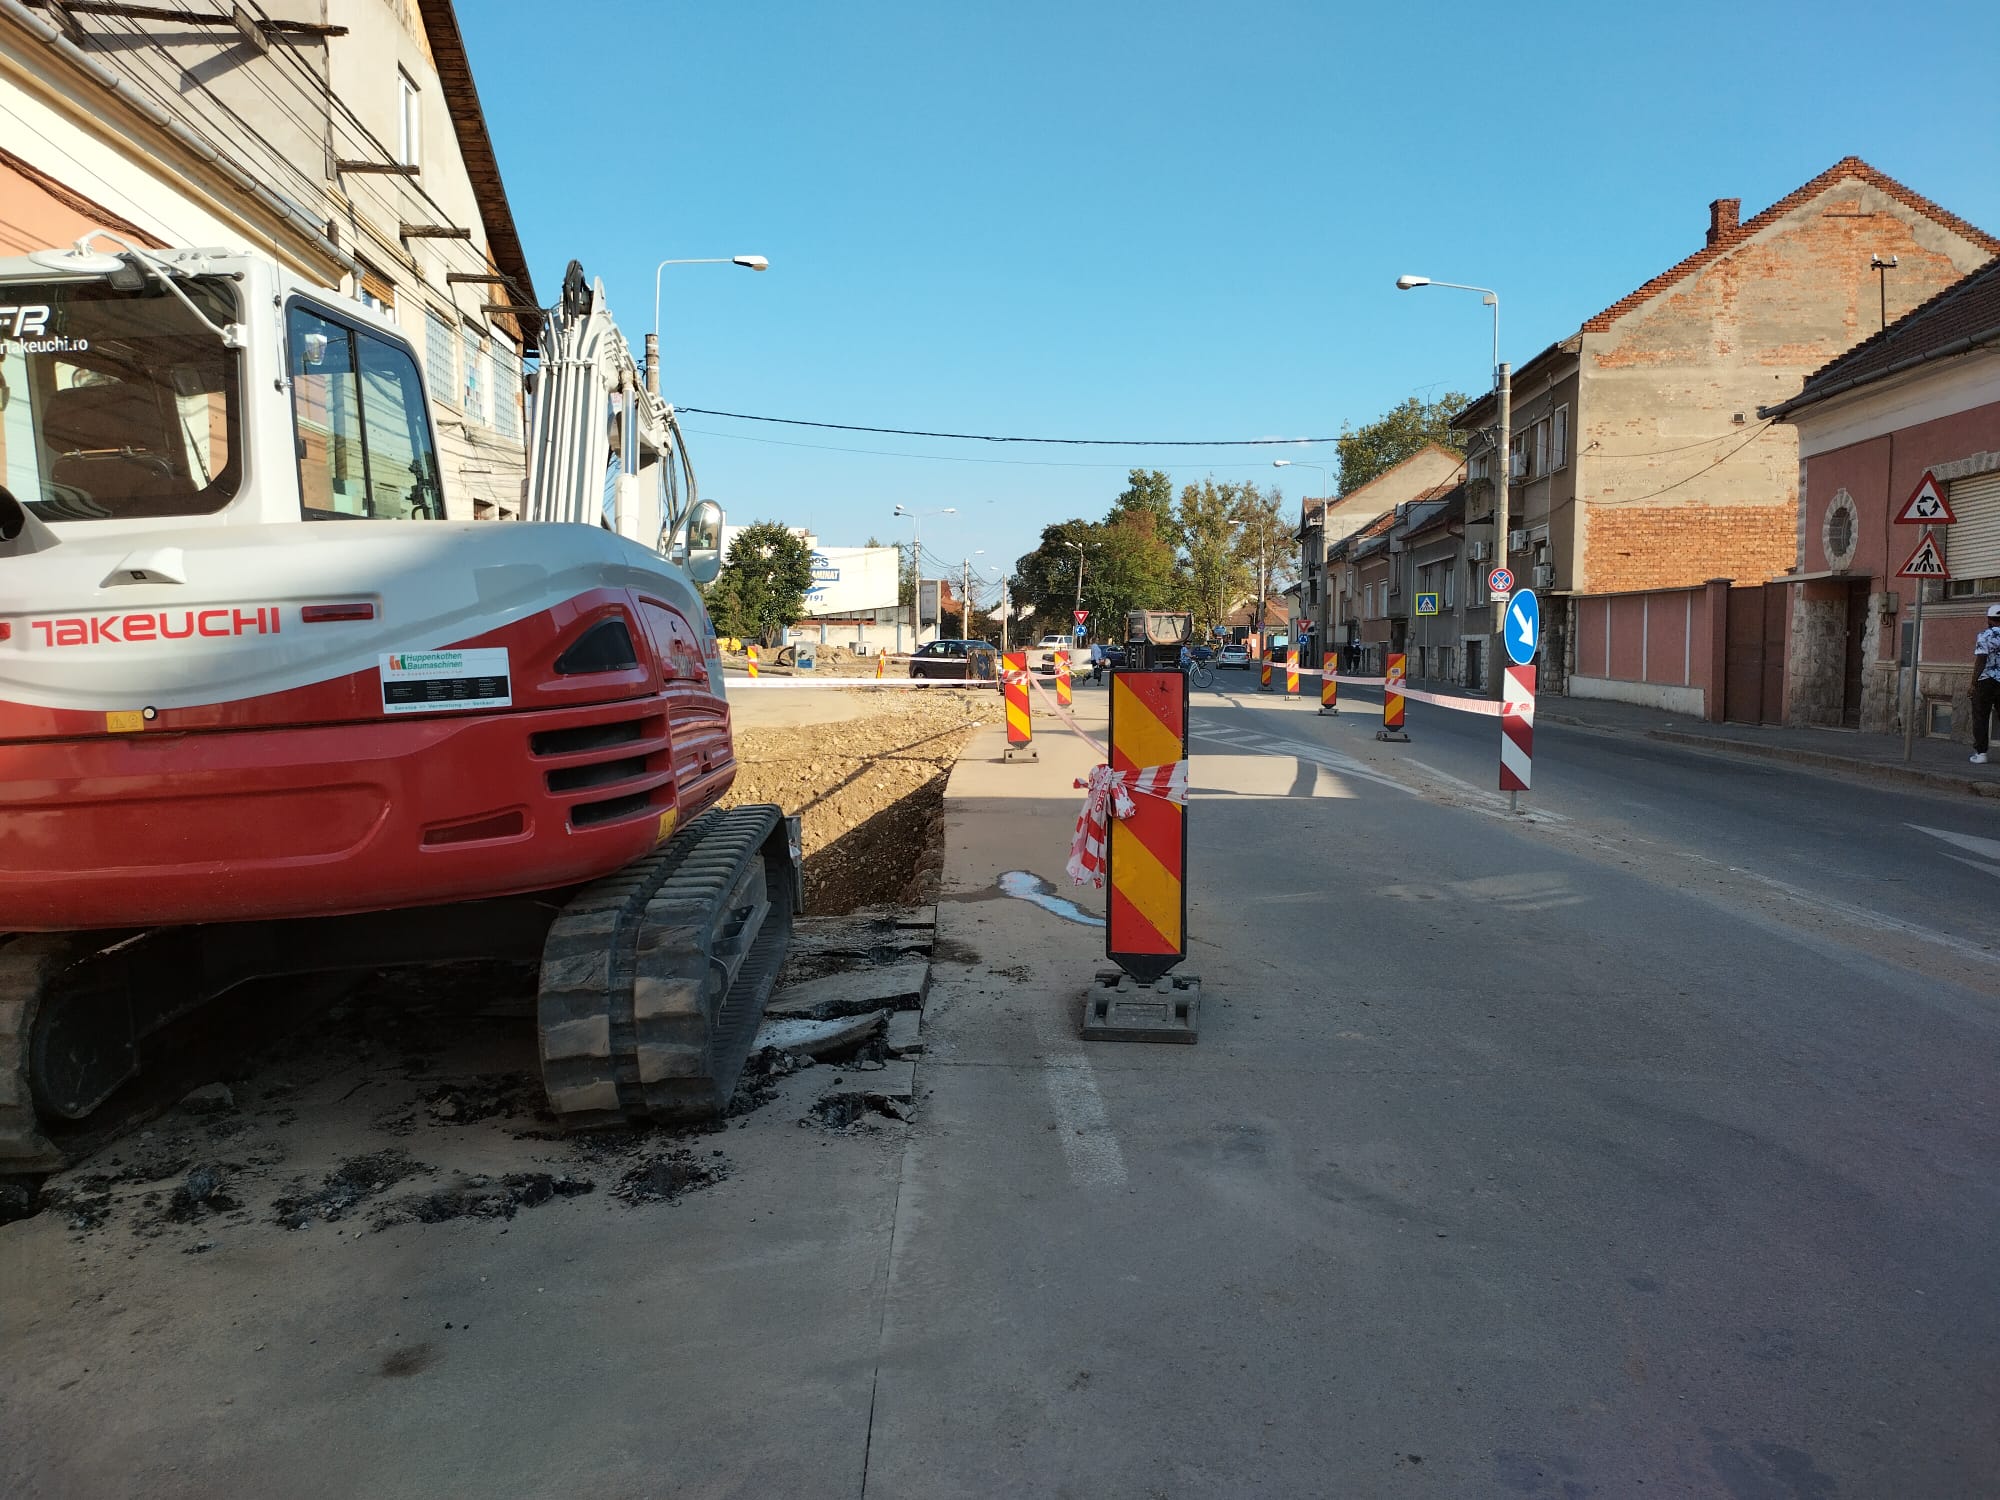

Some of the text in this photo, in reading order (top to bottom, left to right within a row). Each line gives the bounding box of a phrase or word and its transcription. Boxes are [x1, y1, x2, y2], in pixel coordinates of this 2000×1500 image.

[32, 606, 281, 647] TAKEUCHI
[406, 652, 462, 662] Huppenkothen
[407, 661, 463, 670] Baumaschinen
